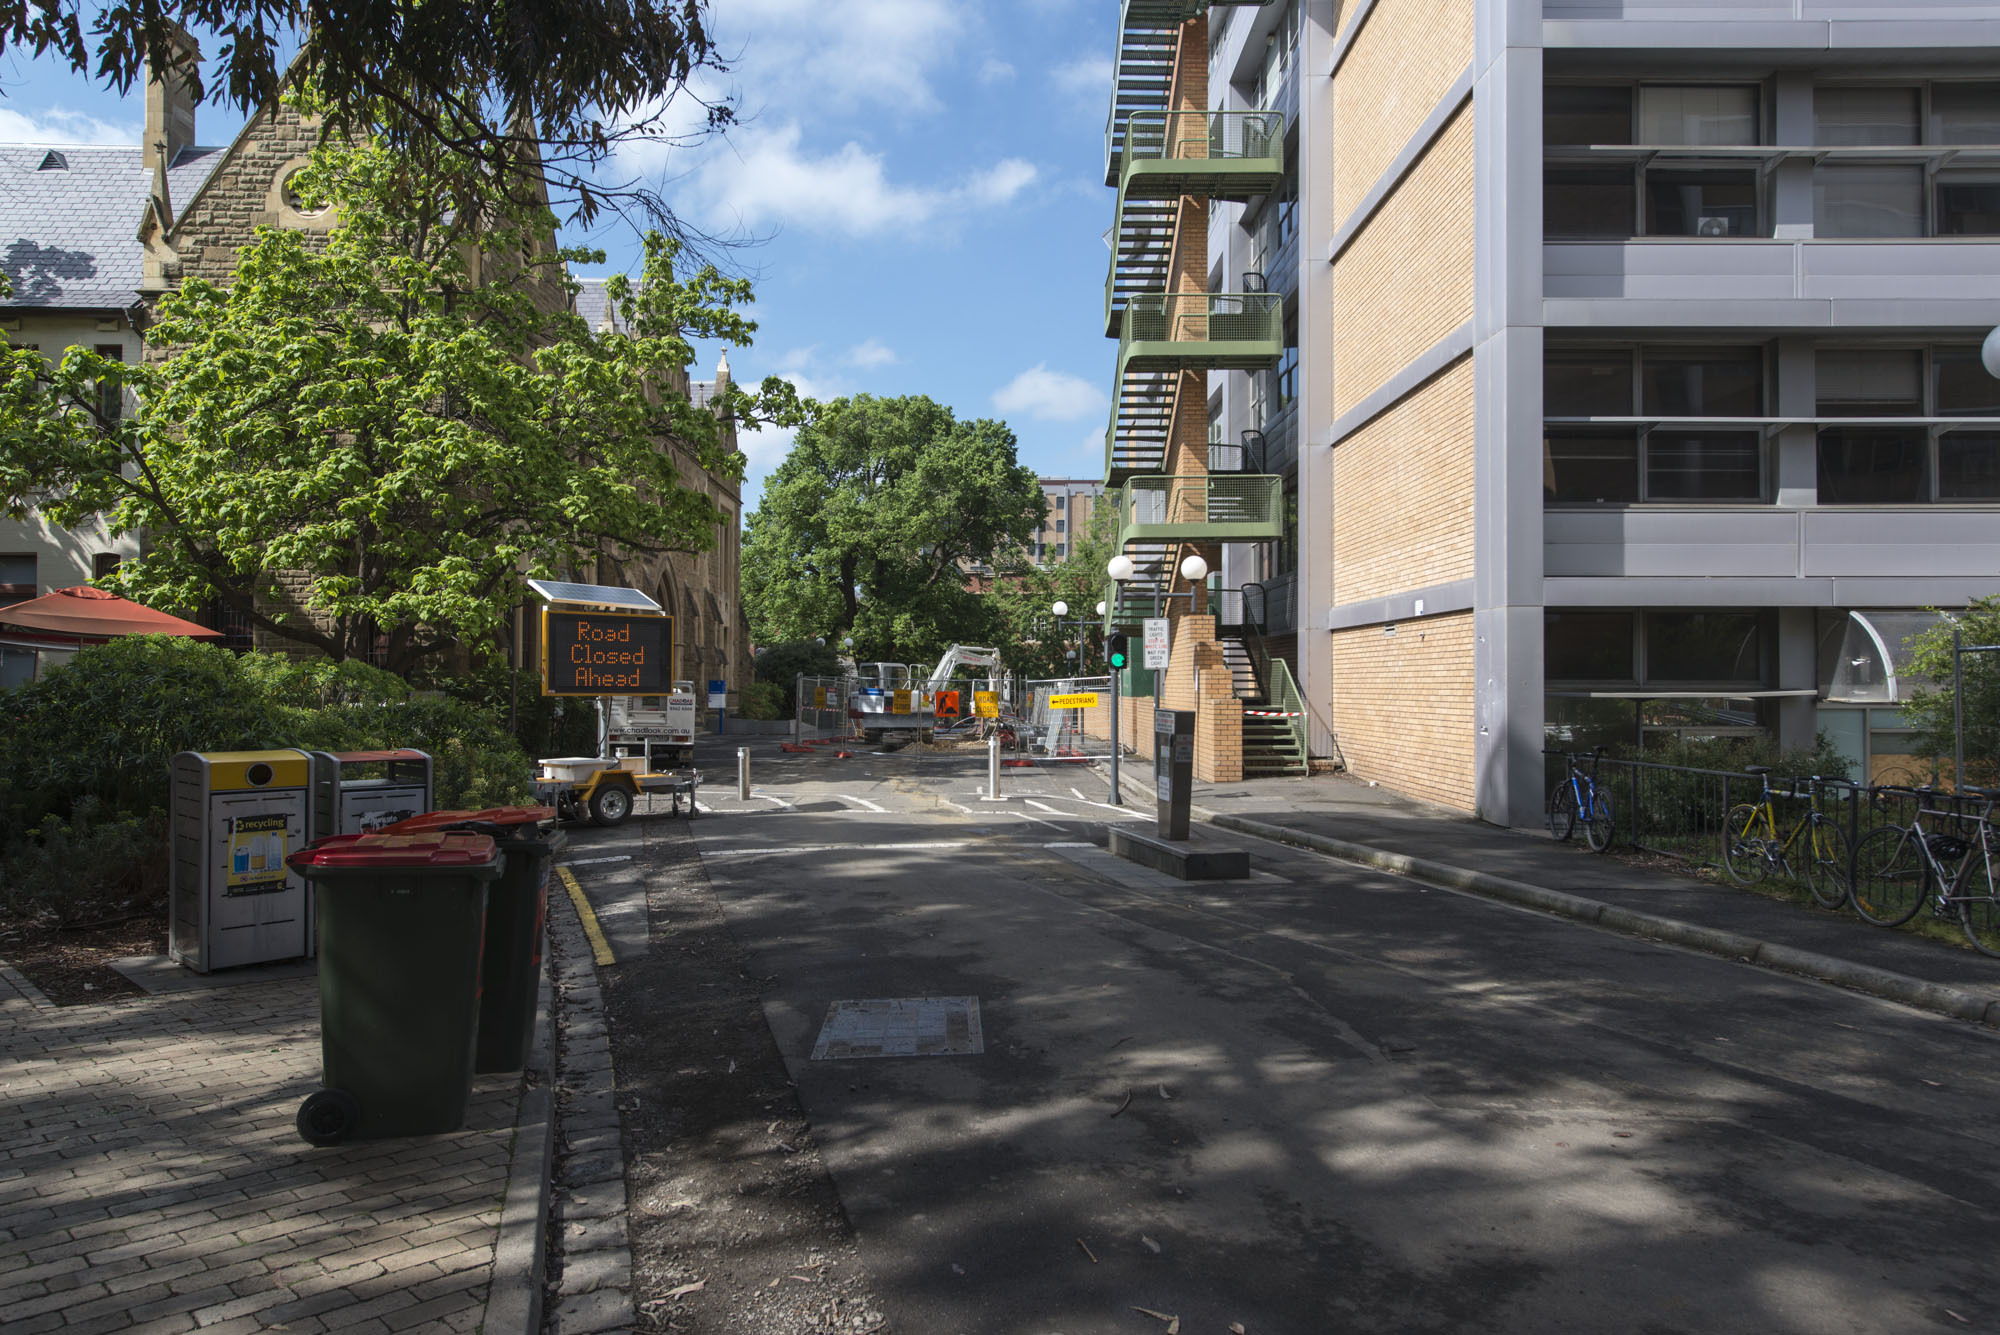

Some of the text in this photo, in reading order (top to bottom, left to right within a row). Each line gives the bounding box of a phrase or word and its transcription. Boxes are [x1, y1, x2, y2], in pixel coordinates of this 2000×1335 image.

[578, 621, 630, 642] Road
[571, 644, 644, 664] Closed
[576, 667, 640, 687] Ahead
[976, 705, 997, 713] CLOSED
[1059, 697, 1095, 705] PEDESTRIANS
[245, 818, 285, 830] recycling
